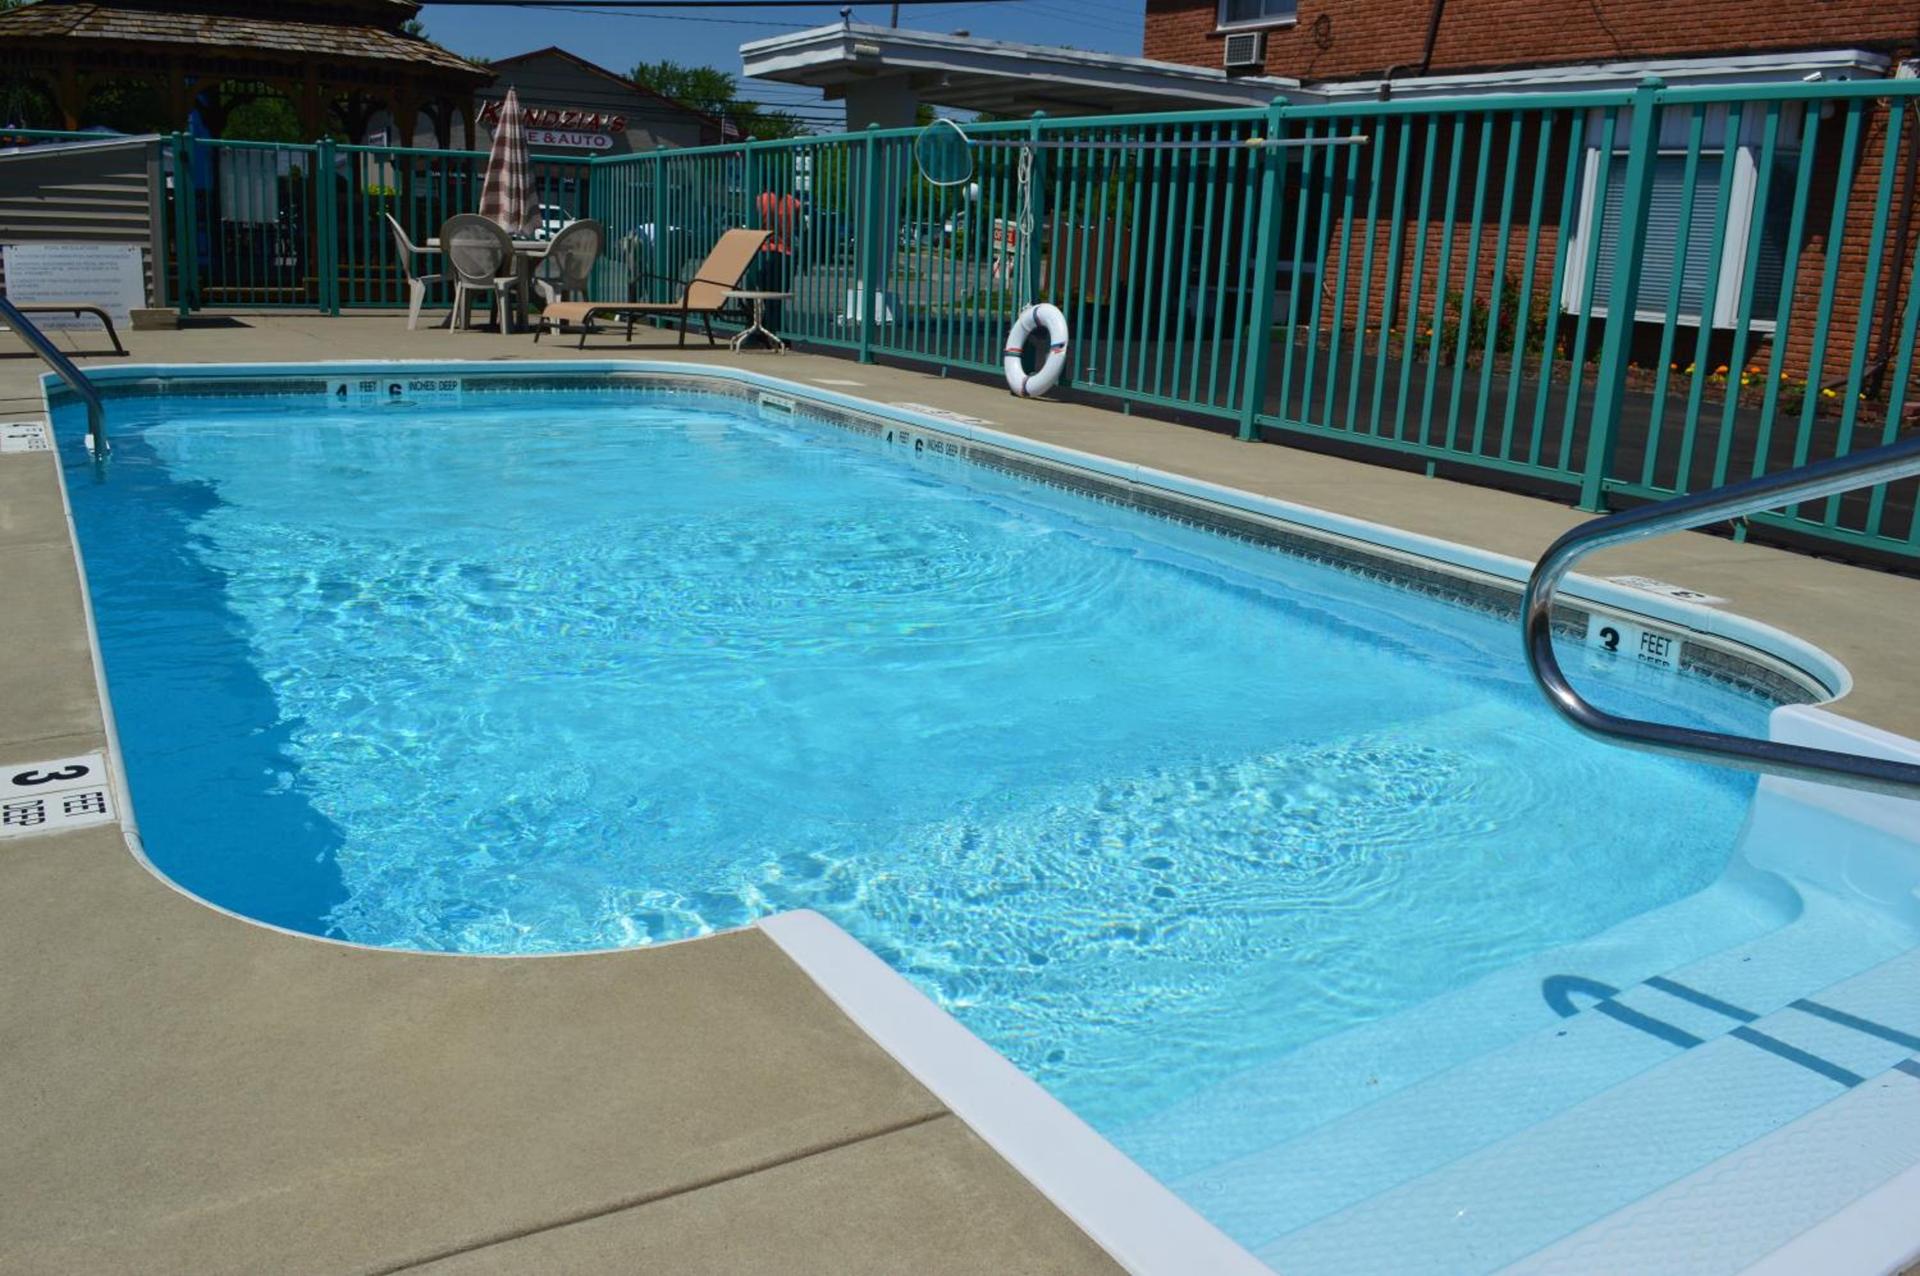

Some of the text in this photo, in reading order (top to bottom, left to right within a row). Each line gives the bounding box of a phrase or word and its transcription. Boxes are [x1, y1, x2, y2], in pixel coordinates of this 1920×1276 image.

[475, 99, 627, 134] KNDZIA'S
[543, 132, 557, 144] &
[558, 135, 606, 148] AUTO
[360, 381, 376, 392] FEET
[409, 380, 437, 391] INCHES
[439, 380, 458, 391] DEEP
[1640, 632, 1672, 657] FEET
[11, 764, 106, 817] 3 FEET
[3, 799, 46, 826] DEEP
